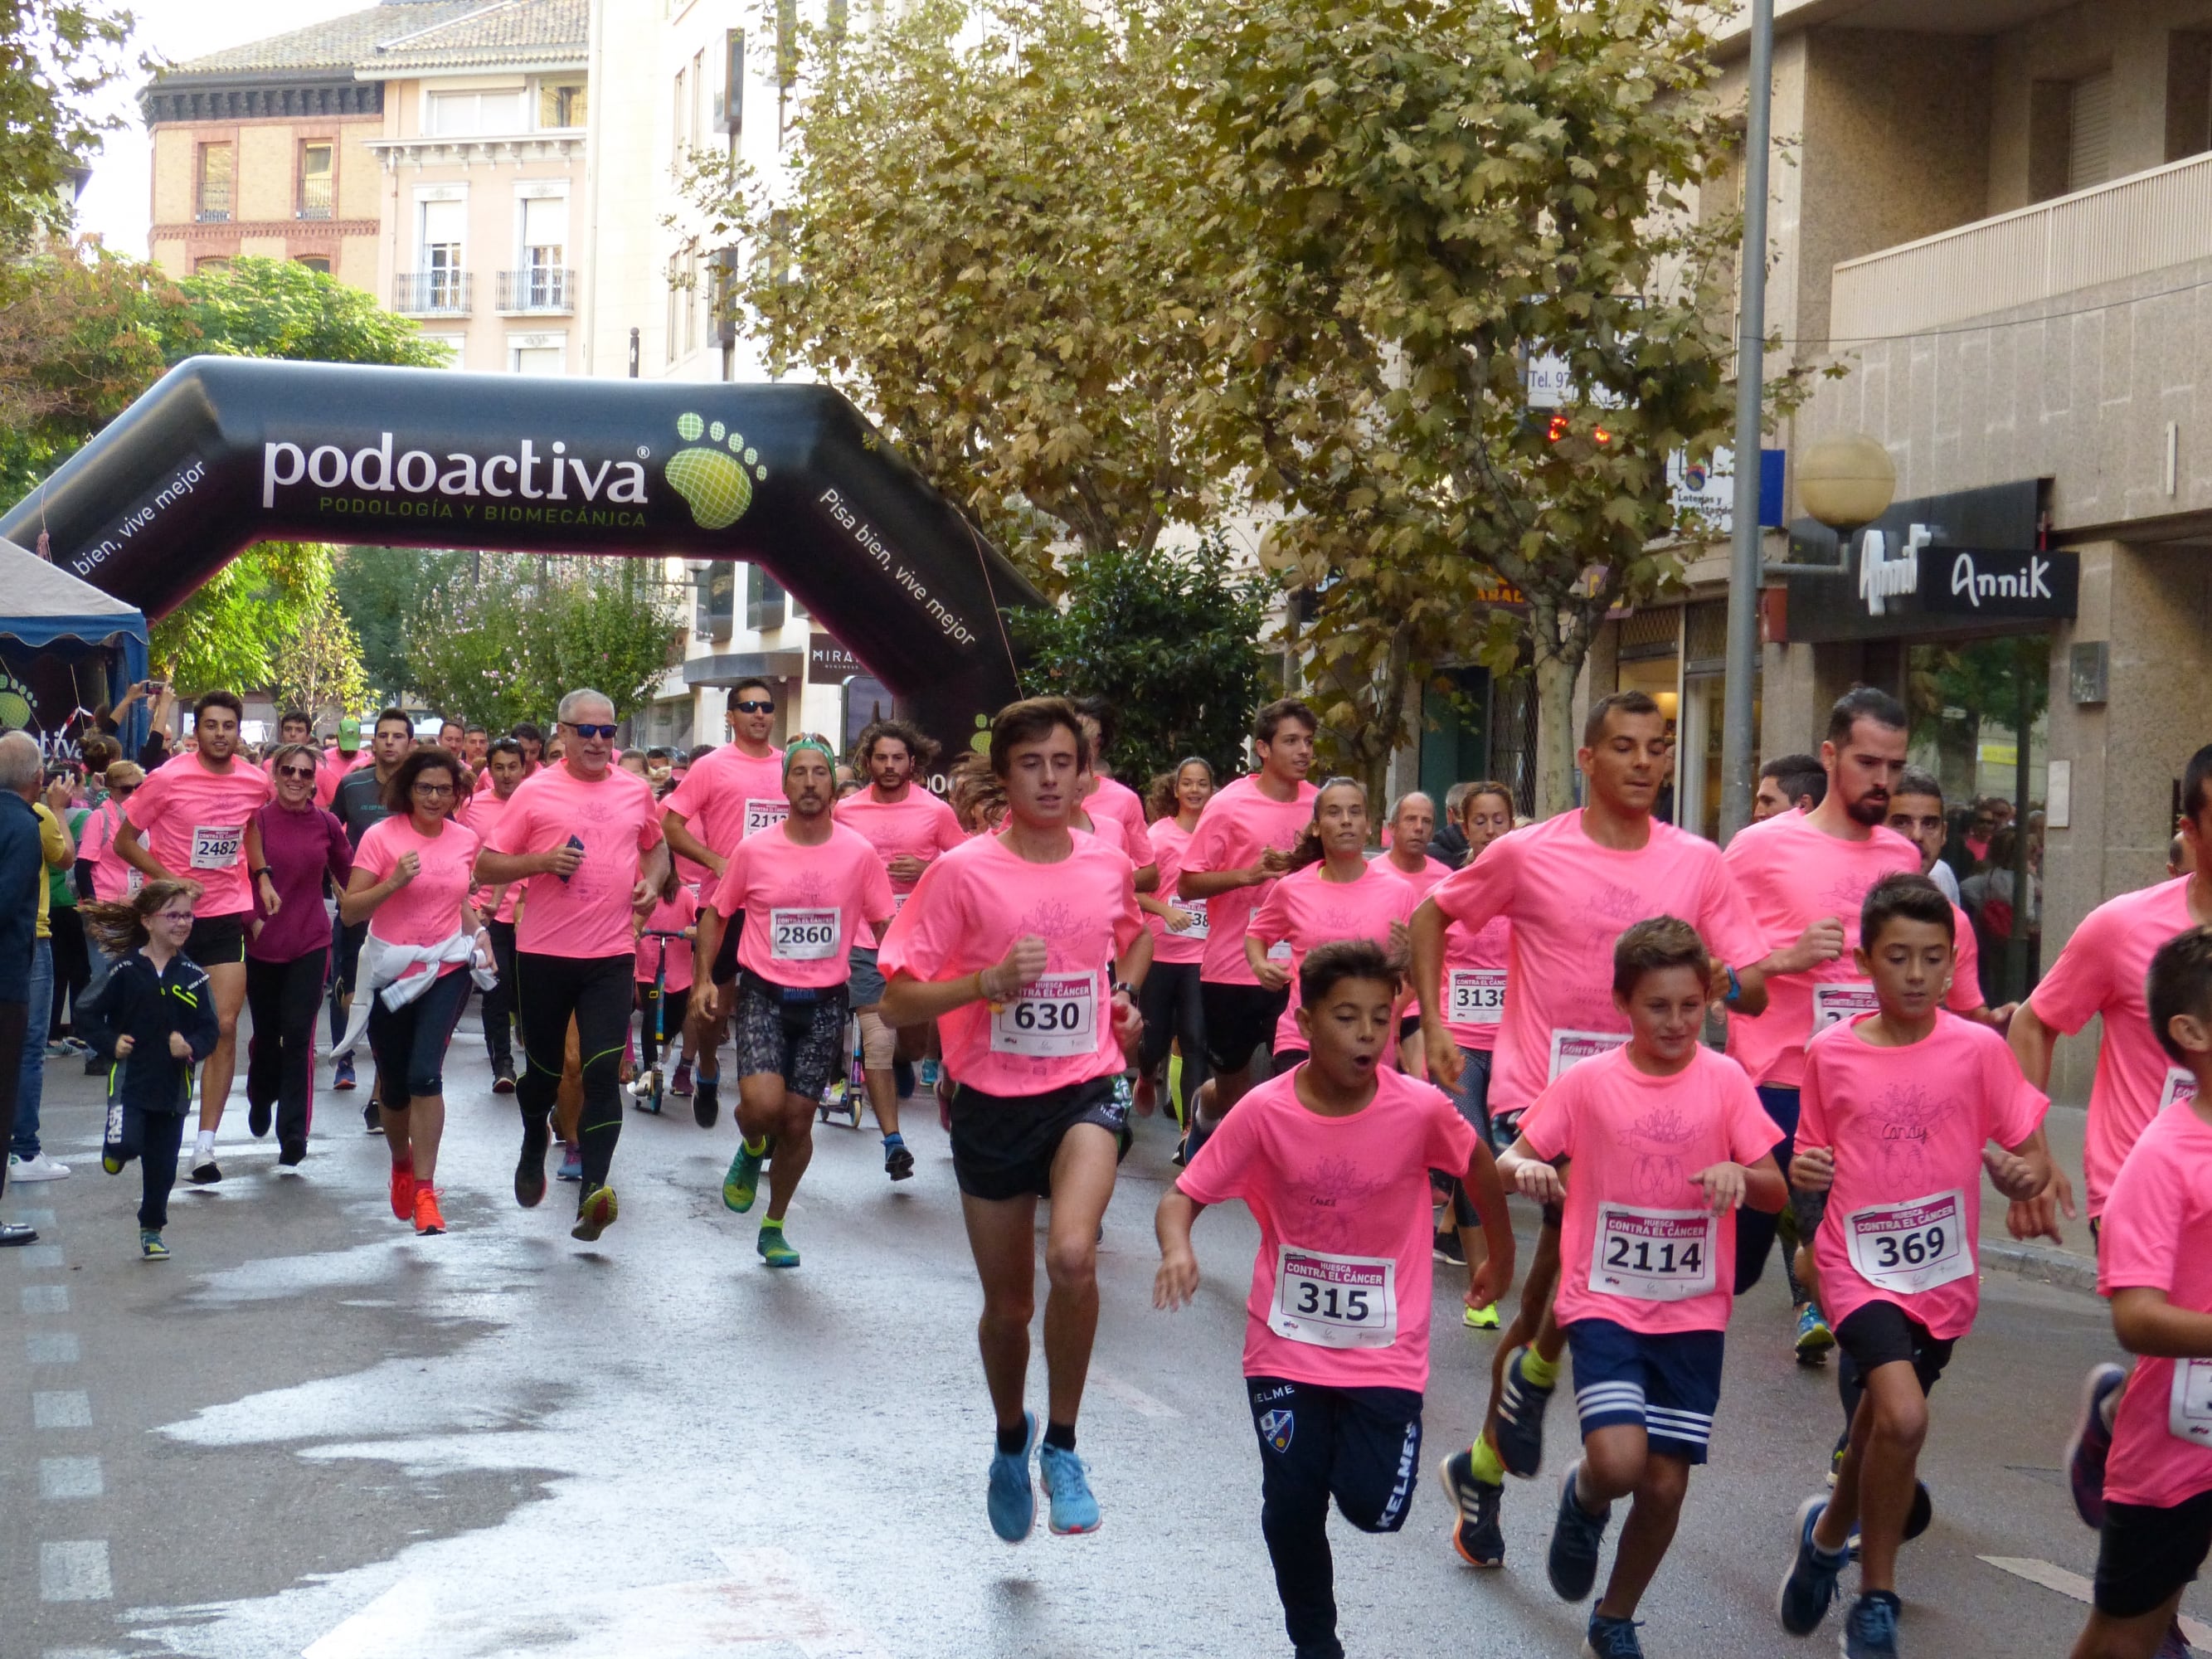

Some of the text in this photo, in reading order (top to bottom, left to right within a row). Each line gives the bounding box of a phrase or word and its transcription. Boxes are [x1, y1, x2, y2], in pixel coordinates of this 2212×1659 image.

[1529, 372, 1551, 388] Tel.
[72, 460, 206, 576] bien, vive mejor
[319, 497, 646, 528] PODOLOGÍA Y BIOMECÁNICA
[819, 488, 975, 645] Pisa bien, vive mejor
[813, 650, 859, 662] MIRA
[198, 840, 237, 855] 2482
[779, 927, 833, 943] 2860
[1057, 985, 1090, 997] CÁNCER
[1015, 1002, 1080, 1030] 630
[1644, 1219, 1675, 1228] HUESCA
[1857, 1205, 1955, 1232] CONTRA EL CÁNCER
[1892, 1209, 1924, 1219] HUESCA
[1609, 1219, 1705, 1237] CONTRA EL CÁNCER
[1607, 1236, 1701, 1272] 2114
[1876, 1227, 1945, 1267] 369
[1287, 1262, 1383, 1284] CONTRA EL CÁNCER
[1320, 1262, 1351, 1272] HUESCA
[1297, 1282, 1369, 1321] 315
[1375, 1438, 1415, 1528] KELME
